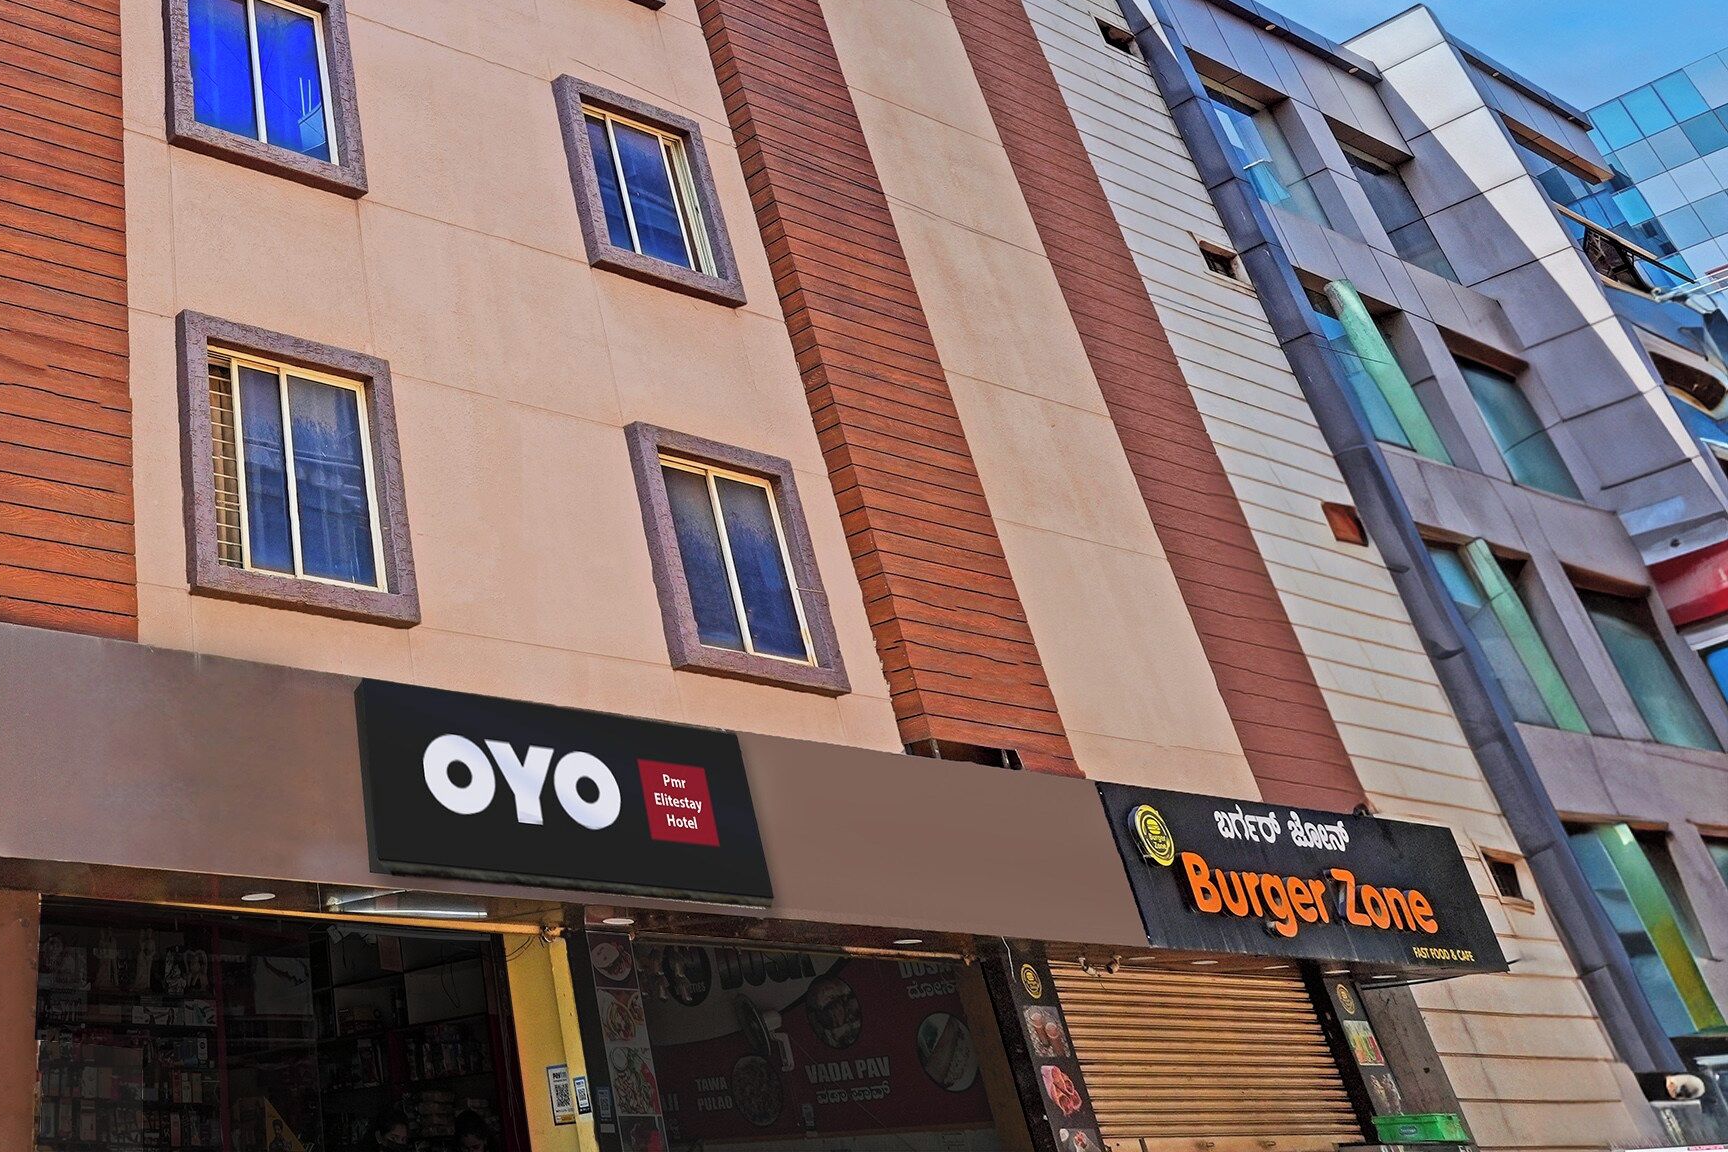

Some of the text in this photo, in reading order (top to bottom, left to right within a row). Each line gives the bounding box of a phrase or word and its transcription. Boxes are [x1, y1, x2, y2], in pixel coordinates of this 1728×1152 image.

[422, 732, 622, 831] OYO
[662, 773, 687, 789] Pmr
[653, 792, 703, 814] Elitestay
[666, 813, 699, 831] Hotel
[1213, 803, 1350, 852] ಬರ್ಗರ್ ಜೋನ್
[1180, 851, 1439, 939] Burger Zone
[1412, 946, 1475, 962] FAST FOOD & CAFE
[804, 1056, 891, 1084] VADA PAV
[695, 1076, 728, 1092] TAWA
[696, 1096, 733, 1112] PULAO
